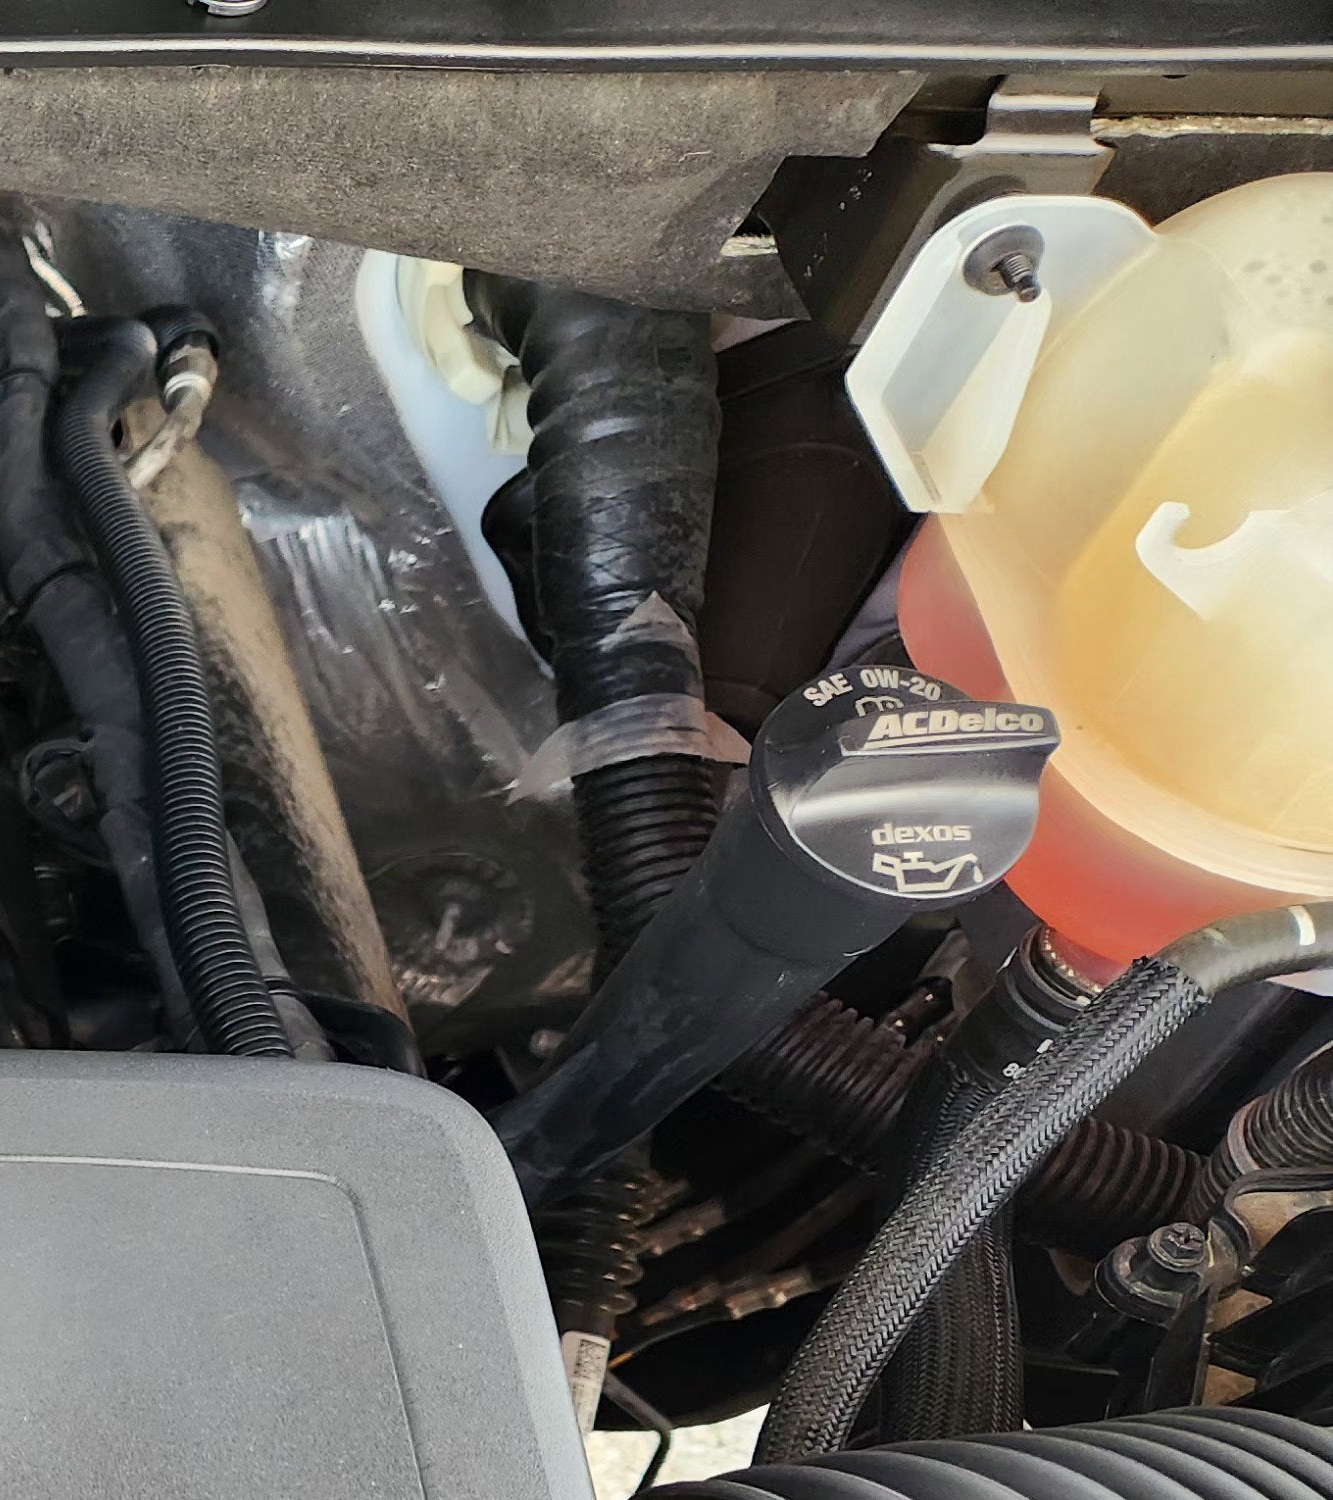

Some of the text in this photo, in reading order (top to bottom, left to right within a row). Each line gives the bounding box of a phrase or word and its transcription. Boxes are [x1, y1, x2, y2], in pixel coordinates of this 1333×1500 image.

[803, 668, 941, 707] SAE 0W-20
[867, 707, 1044, 741] ACDelco
[871, 822, 973, 846] dexos
